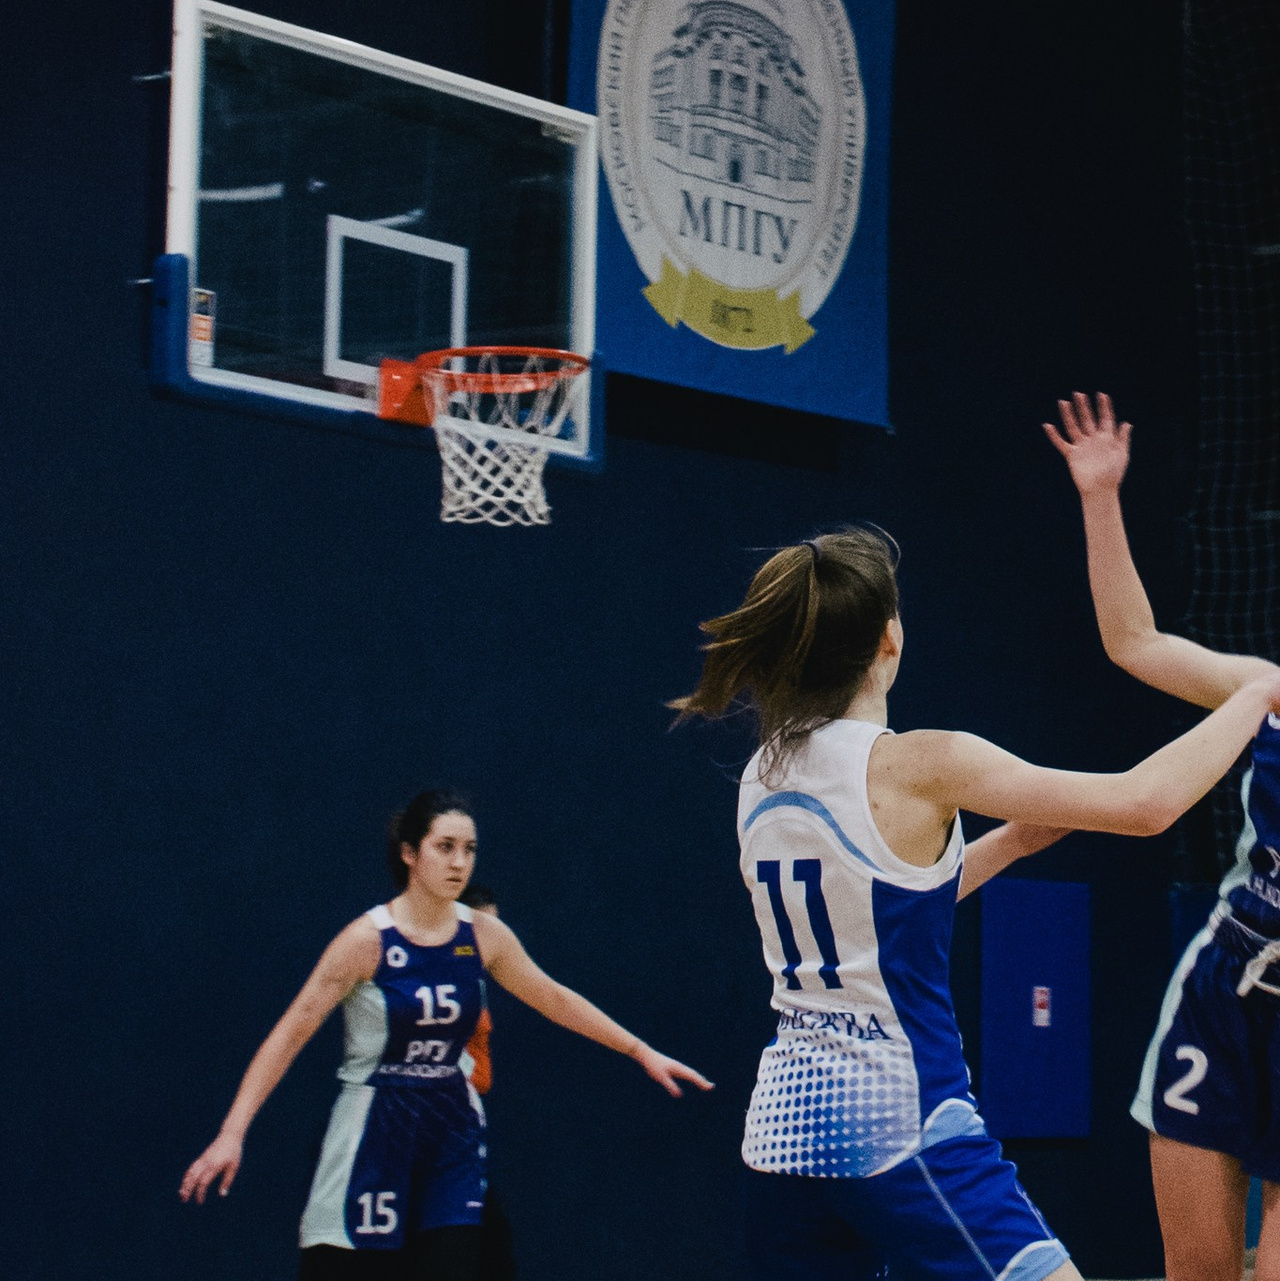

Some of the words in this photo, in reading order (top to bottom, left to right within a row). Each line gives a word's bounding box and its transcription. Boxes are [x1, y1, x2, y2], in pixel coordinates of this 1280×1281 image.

[678, 189, 799, 264] МПГУ
[756, 859, 844, 991] 11
[415, 984, 461, 1026] 15
[1163, 1045, 1209, 1116] 2
[356, 1190, 398, 1235] 15
